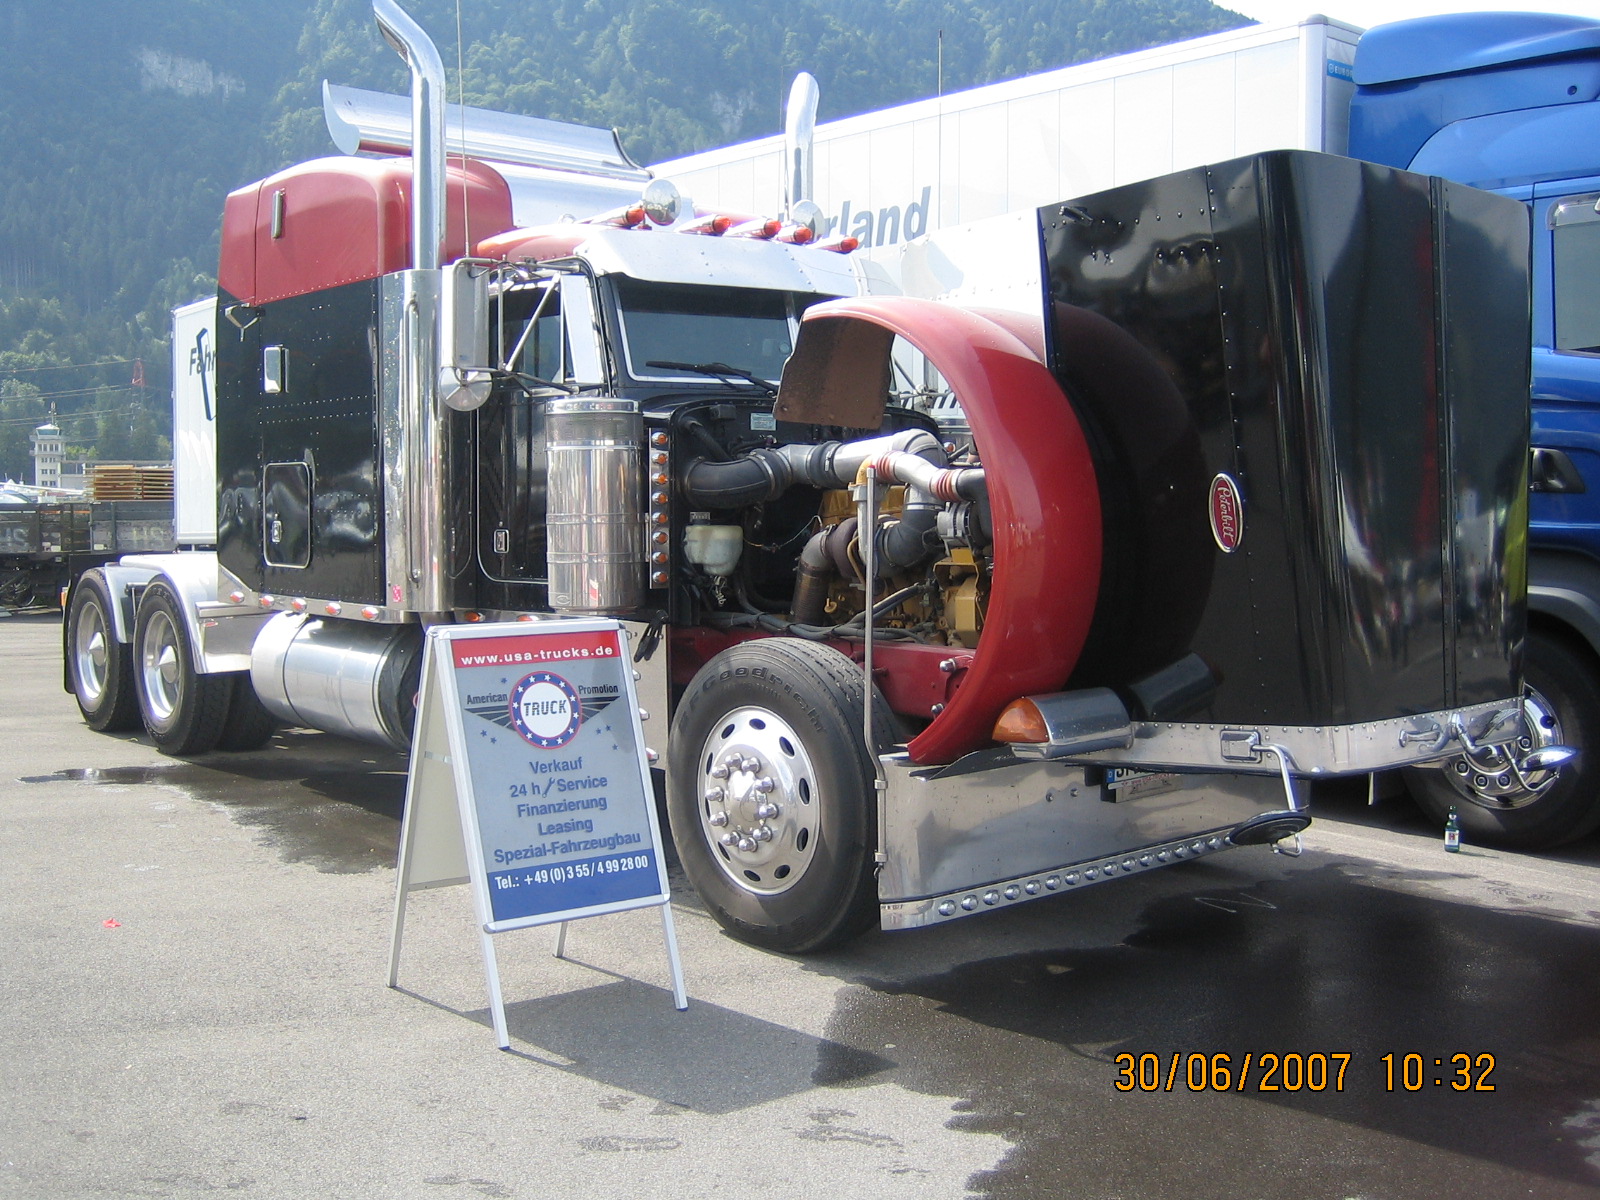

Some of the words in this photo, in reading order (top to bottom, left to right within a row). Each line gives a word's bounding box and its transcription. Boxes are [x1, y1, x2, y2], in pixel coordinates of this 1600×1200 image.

[778, 186, 931, 250] rland
[1217, 486, 1235, 543] Peterbilt
[461, 645, 614, 666] www.usa-trucks.de
[466, 692, 508, 705] American
[578, 684, 619, 695] Promotion
[523, 699, 567, 716] TRUCK
[529, 756, 583, 775] Verkauf
[509, 784, 528, 798] 24
[532, 782, 541, 795] h
[557, 775, 608, 793] Service
[517, 796, 608, 818] Finanzierung
[537, 818, 594, 836] Leasing
[494, 832, 641, 865] Spezial-Fahrzeugbau
[494, 876, 520, 890] Tel.:
